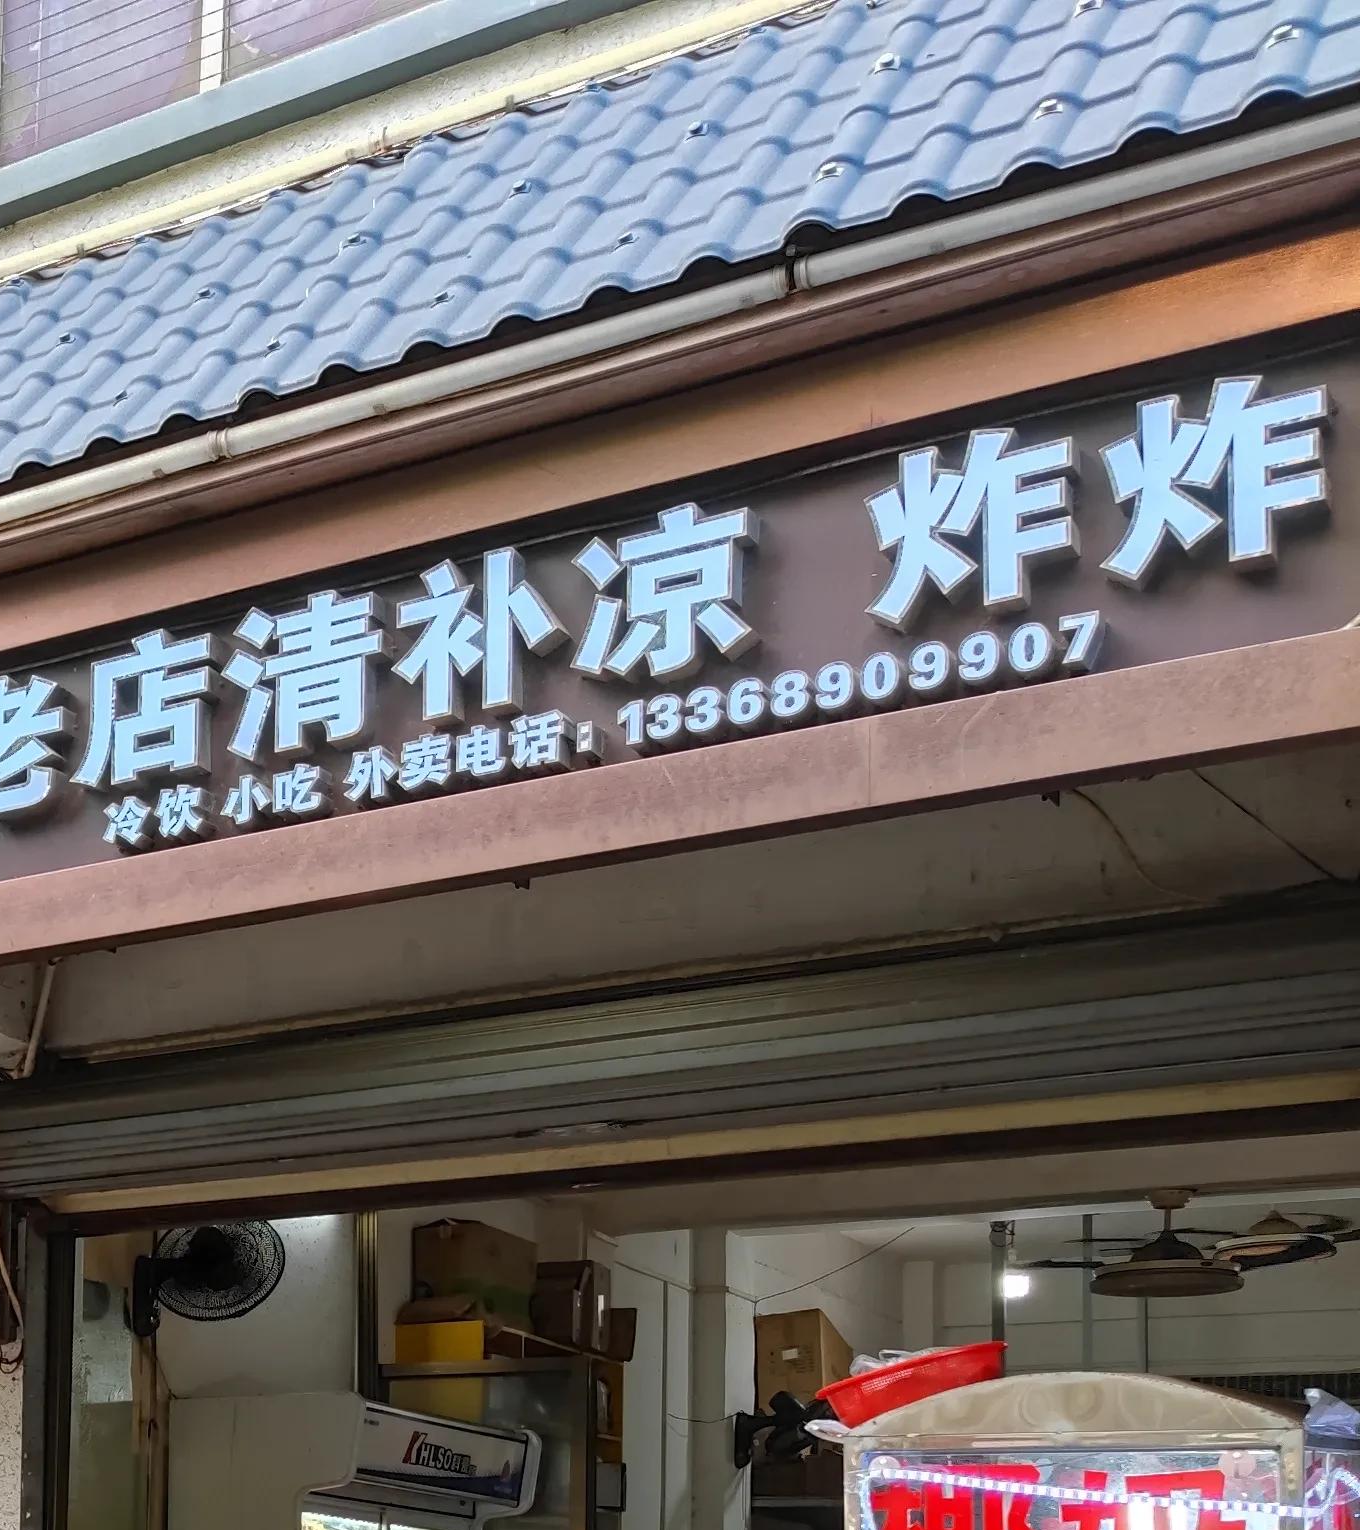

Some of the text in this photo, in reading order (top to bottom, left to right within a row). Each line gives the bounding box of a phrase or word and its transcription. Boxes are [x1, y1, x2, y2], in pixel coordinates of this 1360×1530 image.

[863, 376, 1330, 630] 炸炸
[102, 784, 204, 846] 冷饮
[223, 765, 325, 825] 小吃
